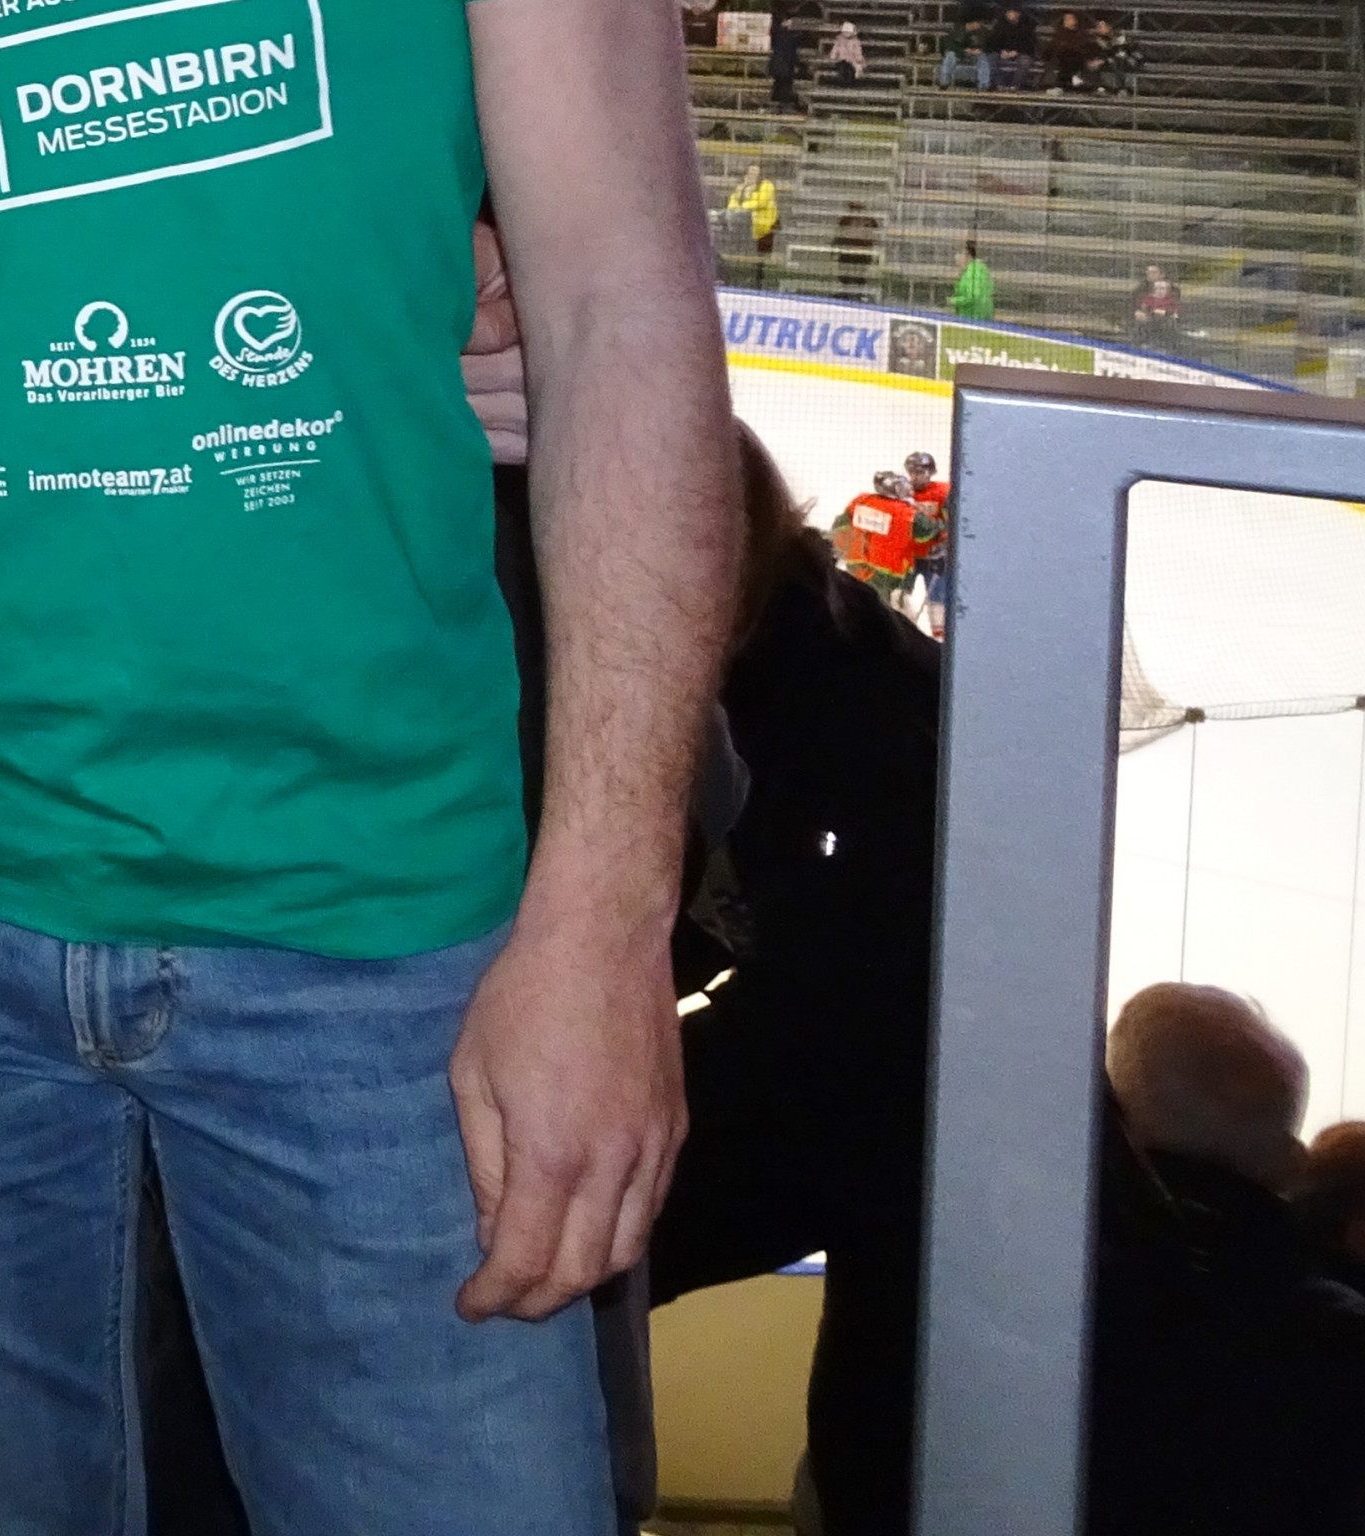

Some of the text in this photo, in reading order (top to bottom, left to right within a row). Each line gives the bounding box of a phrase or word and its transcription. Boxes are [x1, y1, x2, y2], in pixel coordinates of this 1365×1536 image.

[16, 33, 295, 123] DORNBIRN
[37, 82, 287, 156] MESSESTADION
[49, 341, 75, 352] SEIT
[726, 312, 882, 360] UTRUCK
[21, 351, 186, 388] MOHREN
[209, 351, 314, 387] DES HERZENS
[27, 384, 185, 403] Das Vorarlberger Bier
[214, 440, 316, 462] WERBUNG
[28, 463, 193, 495] immoteam7.at
[244, 483, 290, 498] ZEICHEN
